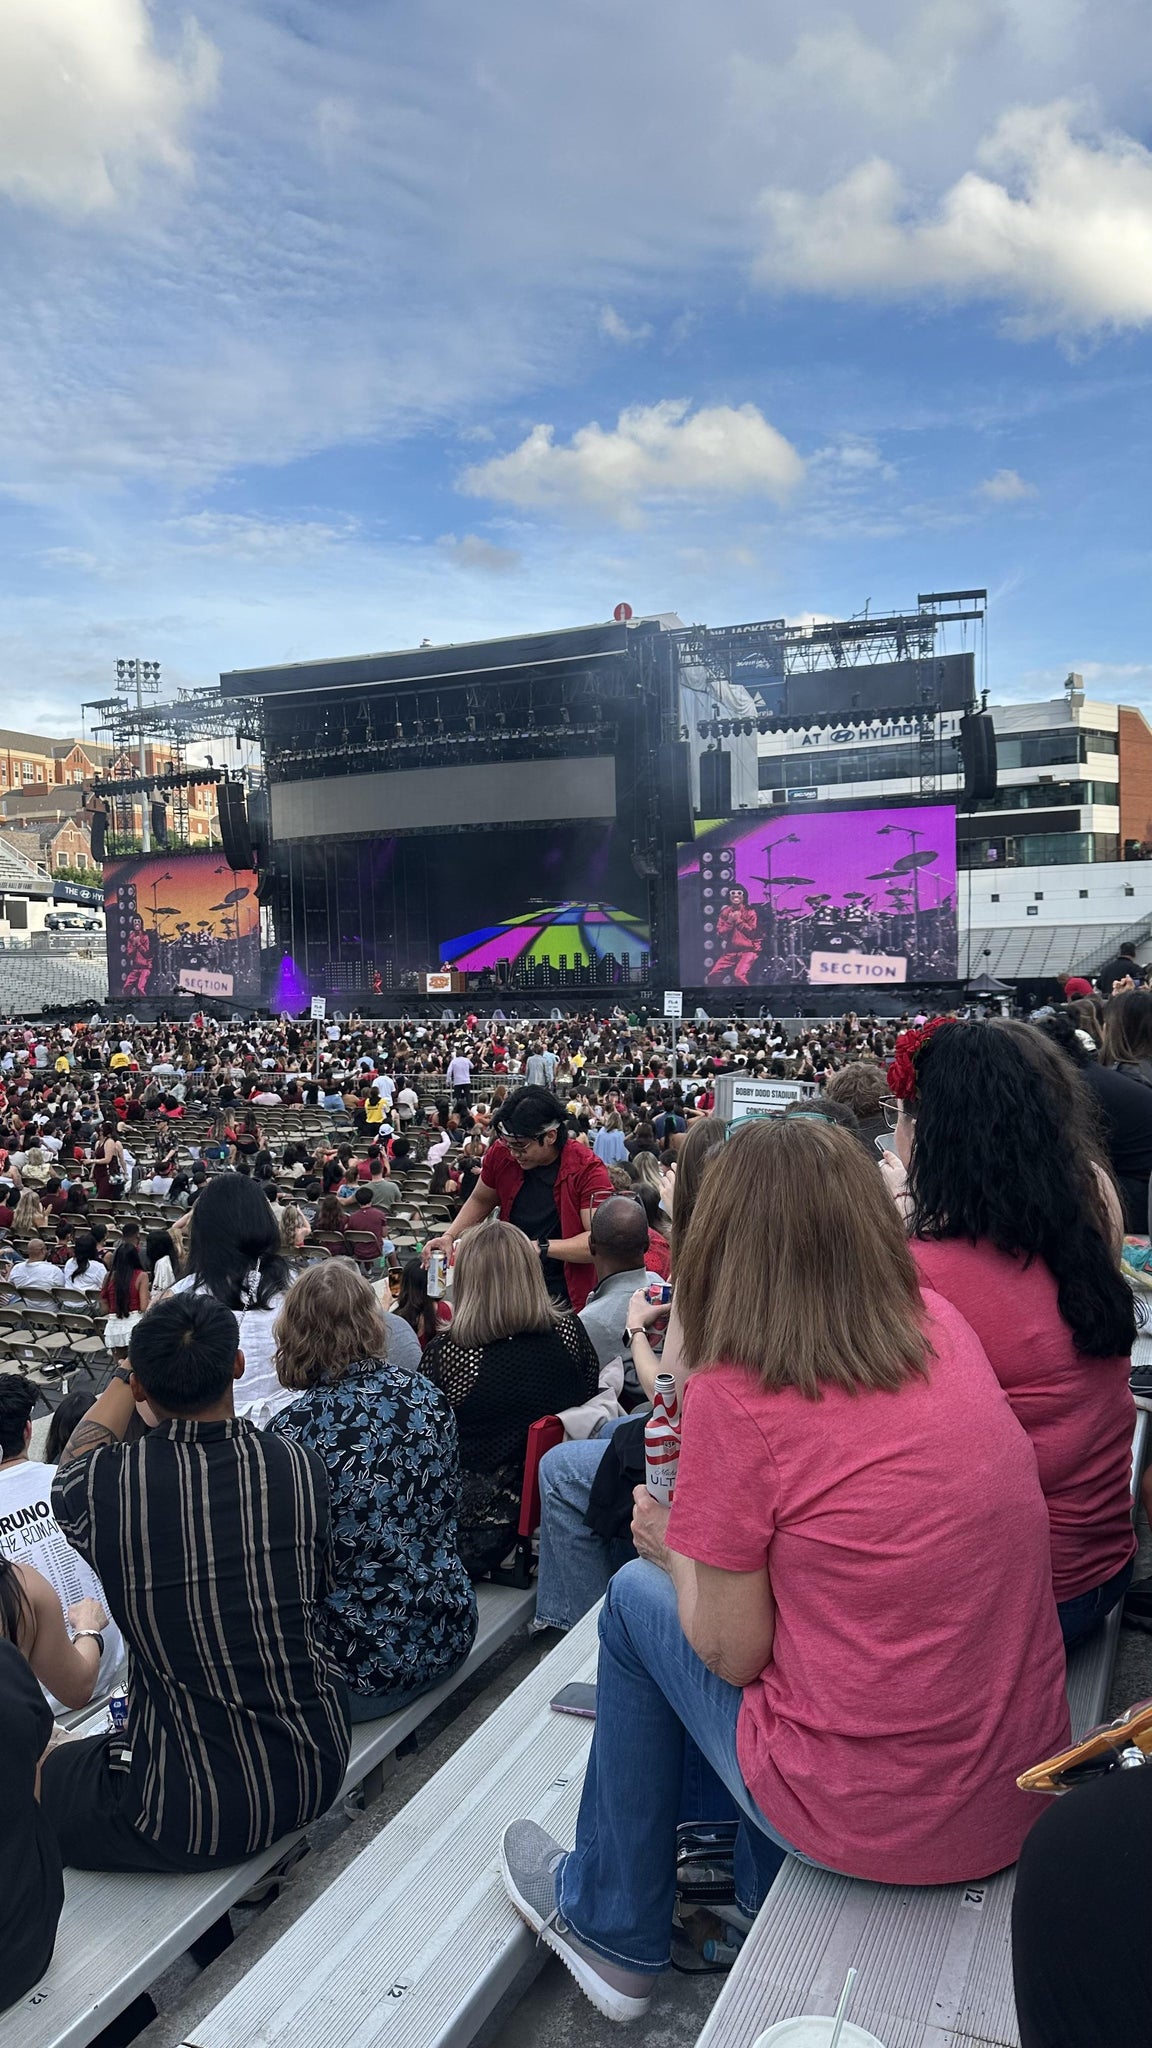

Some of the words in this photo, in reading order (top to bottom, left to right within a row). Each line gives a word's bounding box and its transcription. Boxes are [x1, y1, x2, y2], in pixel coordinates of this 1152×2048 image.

[802, 733, 821, 746] AT
[859, 723, 921, 740] HYUNDA
[65, 886, 79, 896] THE
[820, 961, 897, 977] SECTION
[185, 977, 228, 991] SECTION
[735, 1087, 755, 1097] BOBBY
[771, 1090, 798, 1100] STADIUM
[650, 1474, 676, 1487] ULT
[0, 1501, 50, 1538] RUNO
[0, 1532, 22, 1558] HE
[965, 1888, 984, 1903] 12
[387, 1984, 408, 1998] 12
[29, 1992, 48, 2005] 12
